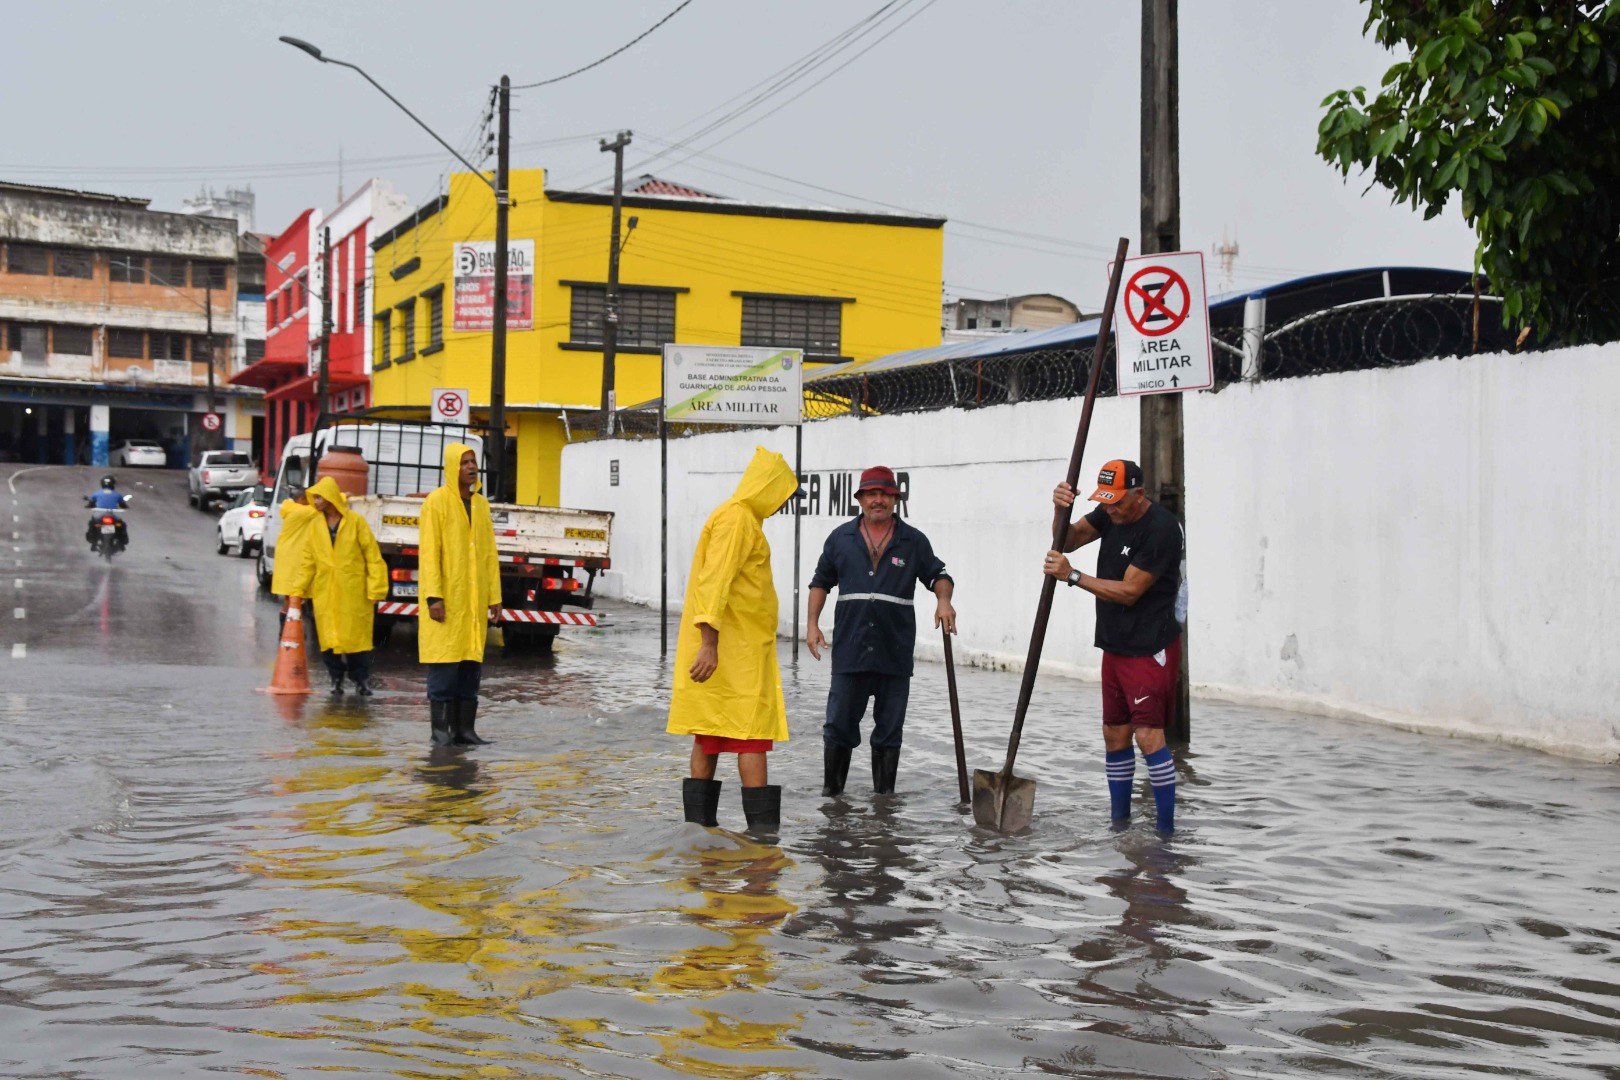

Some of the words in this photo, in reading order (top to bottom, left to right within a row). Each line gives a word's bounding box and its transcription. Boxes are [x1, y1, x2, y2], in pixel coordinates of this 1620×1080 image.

[480, 248, 524, 268] BATÃO
[1140, 338, 1181, 354] ÁREA
[1132, 355, 1192, 373] MILITAR
[679, 382, 722, 391] GUARNIÇÃO
[1138, 380, 1165, 390] INÍCIO
[688, 398, 722, 412] ÁREA
[725, 402, 778, 413] MILITAR
[828, 472, 910, 518] MILR
